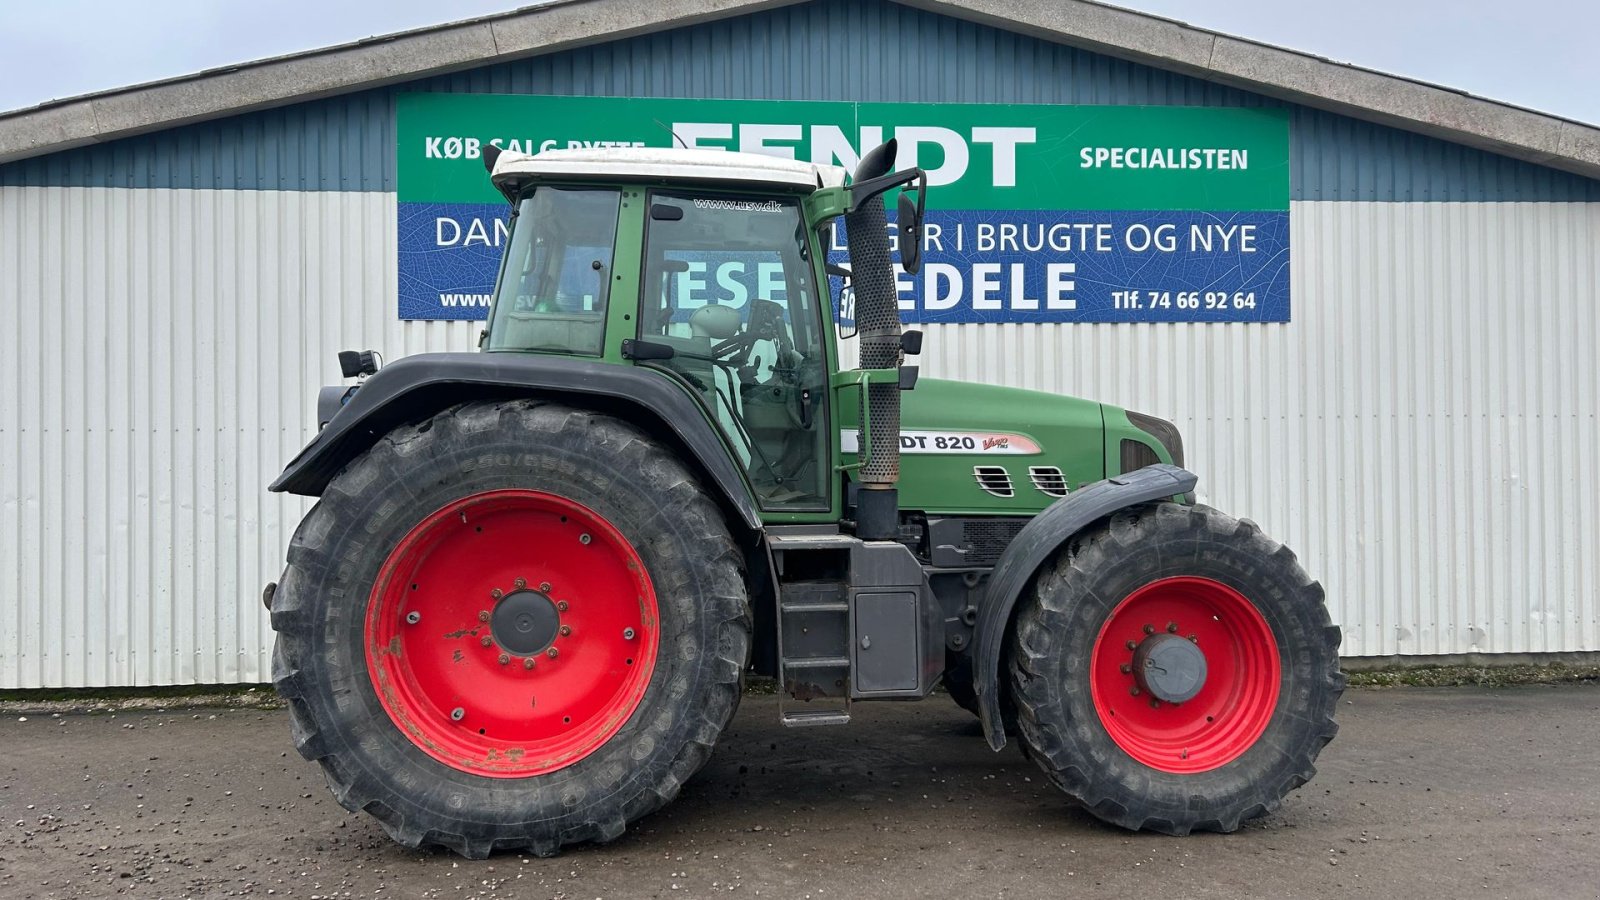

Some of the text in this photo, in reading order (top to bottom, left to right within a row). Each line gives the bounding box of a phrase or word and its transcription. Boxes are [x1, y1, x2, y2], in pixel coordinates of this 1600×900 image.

[425, 136, 480, 159] KØB
[1080, 147, 1248, 170] SPECIALISTEN
[694, 199, 783, 213] www.usv.dk
[956, 224, 962, 251] I
[977, 223, 1112, 252] BRUGTE
[1125, 224, 1178, 252] OG
[1191, 225, 1257, 252] NYE
[1112, 292, 1257, 309] Tlf. 74 66 92 64
[935, 436, 975, 450] 820
